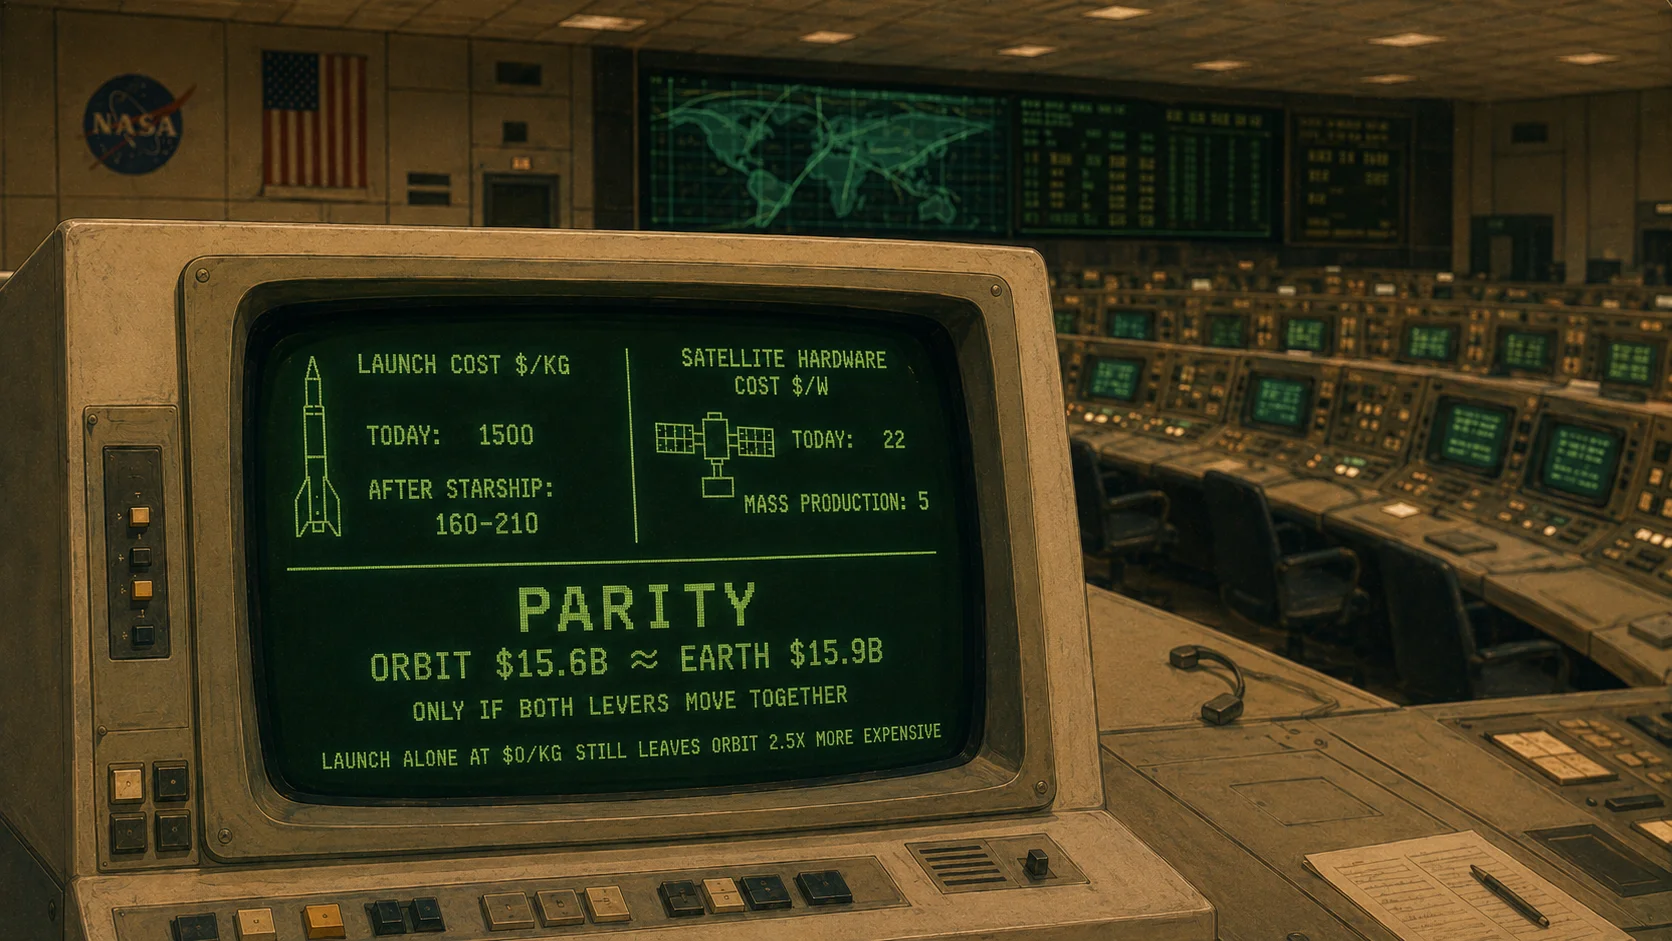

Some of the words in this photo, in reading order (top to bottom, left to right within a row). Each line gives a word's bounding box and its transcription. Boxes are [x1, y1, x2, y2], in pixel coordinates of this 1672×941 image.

[92, 112, 177, 137] NASA
[358, 354, 436, 374] LAUNCH
[451, 354, 500, 374] COST
[515, 352, 570, 376] $/KG
[682, 348, 784, 368] SATELLITE
[798, 350, 887, 369] HARDWARE
[735, 376, 779, 395] COST
[792, 375, 828, 397] $/W
[367, 425, 440, 445] TODAY:
[480, 424, 533, 445] 1500
[792, 430, 852, 448] TODAY:
[884, 430, 905, 448] 22
[369, 479, 432, 500] AFTER
[447, 478, 552, 499] STARSHIP:
[744, 494, 788, 513] MASS
[801, 493, 906, 513] PRODUCTION:
[919, 491, 929, 510] 5
[436, 512, 538, 535] 160-210
[518, 582, 755, 632] PARITY
[370, 651, 471, 682] ORBIT
[496, 647, 607, 680] $15.6B
[681, 643, 770, 671] EARTH
[790, 637, 883, 668] $15.9B
[413, 700, 464, 721] ONLY
[480, 699, 503, 719] IF
[520, 697, 572, 718] BOTH
[590, 694, 668, 715] LEVERS
[686, 690, 736, 711] MOVE
[750, 685, 847, 708] TOGETHER
[322, 750, 390, 769] LAUNCH
[404, 748, 457, 767] ALONE
[471, 747, 489, 765] AT
[576, 742, 626, 760] STILL
[639, 738, 700, 757] LEAVES
[712, 735, 758, 753] ORBIT
[769, 732, 805, 750] 2.5X
[816, 729, 853, 747] MORE
[864, 723, 941, 743] EXPENSIVE
